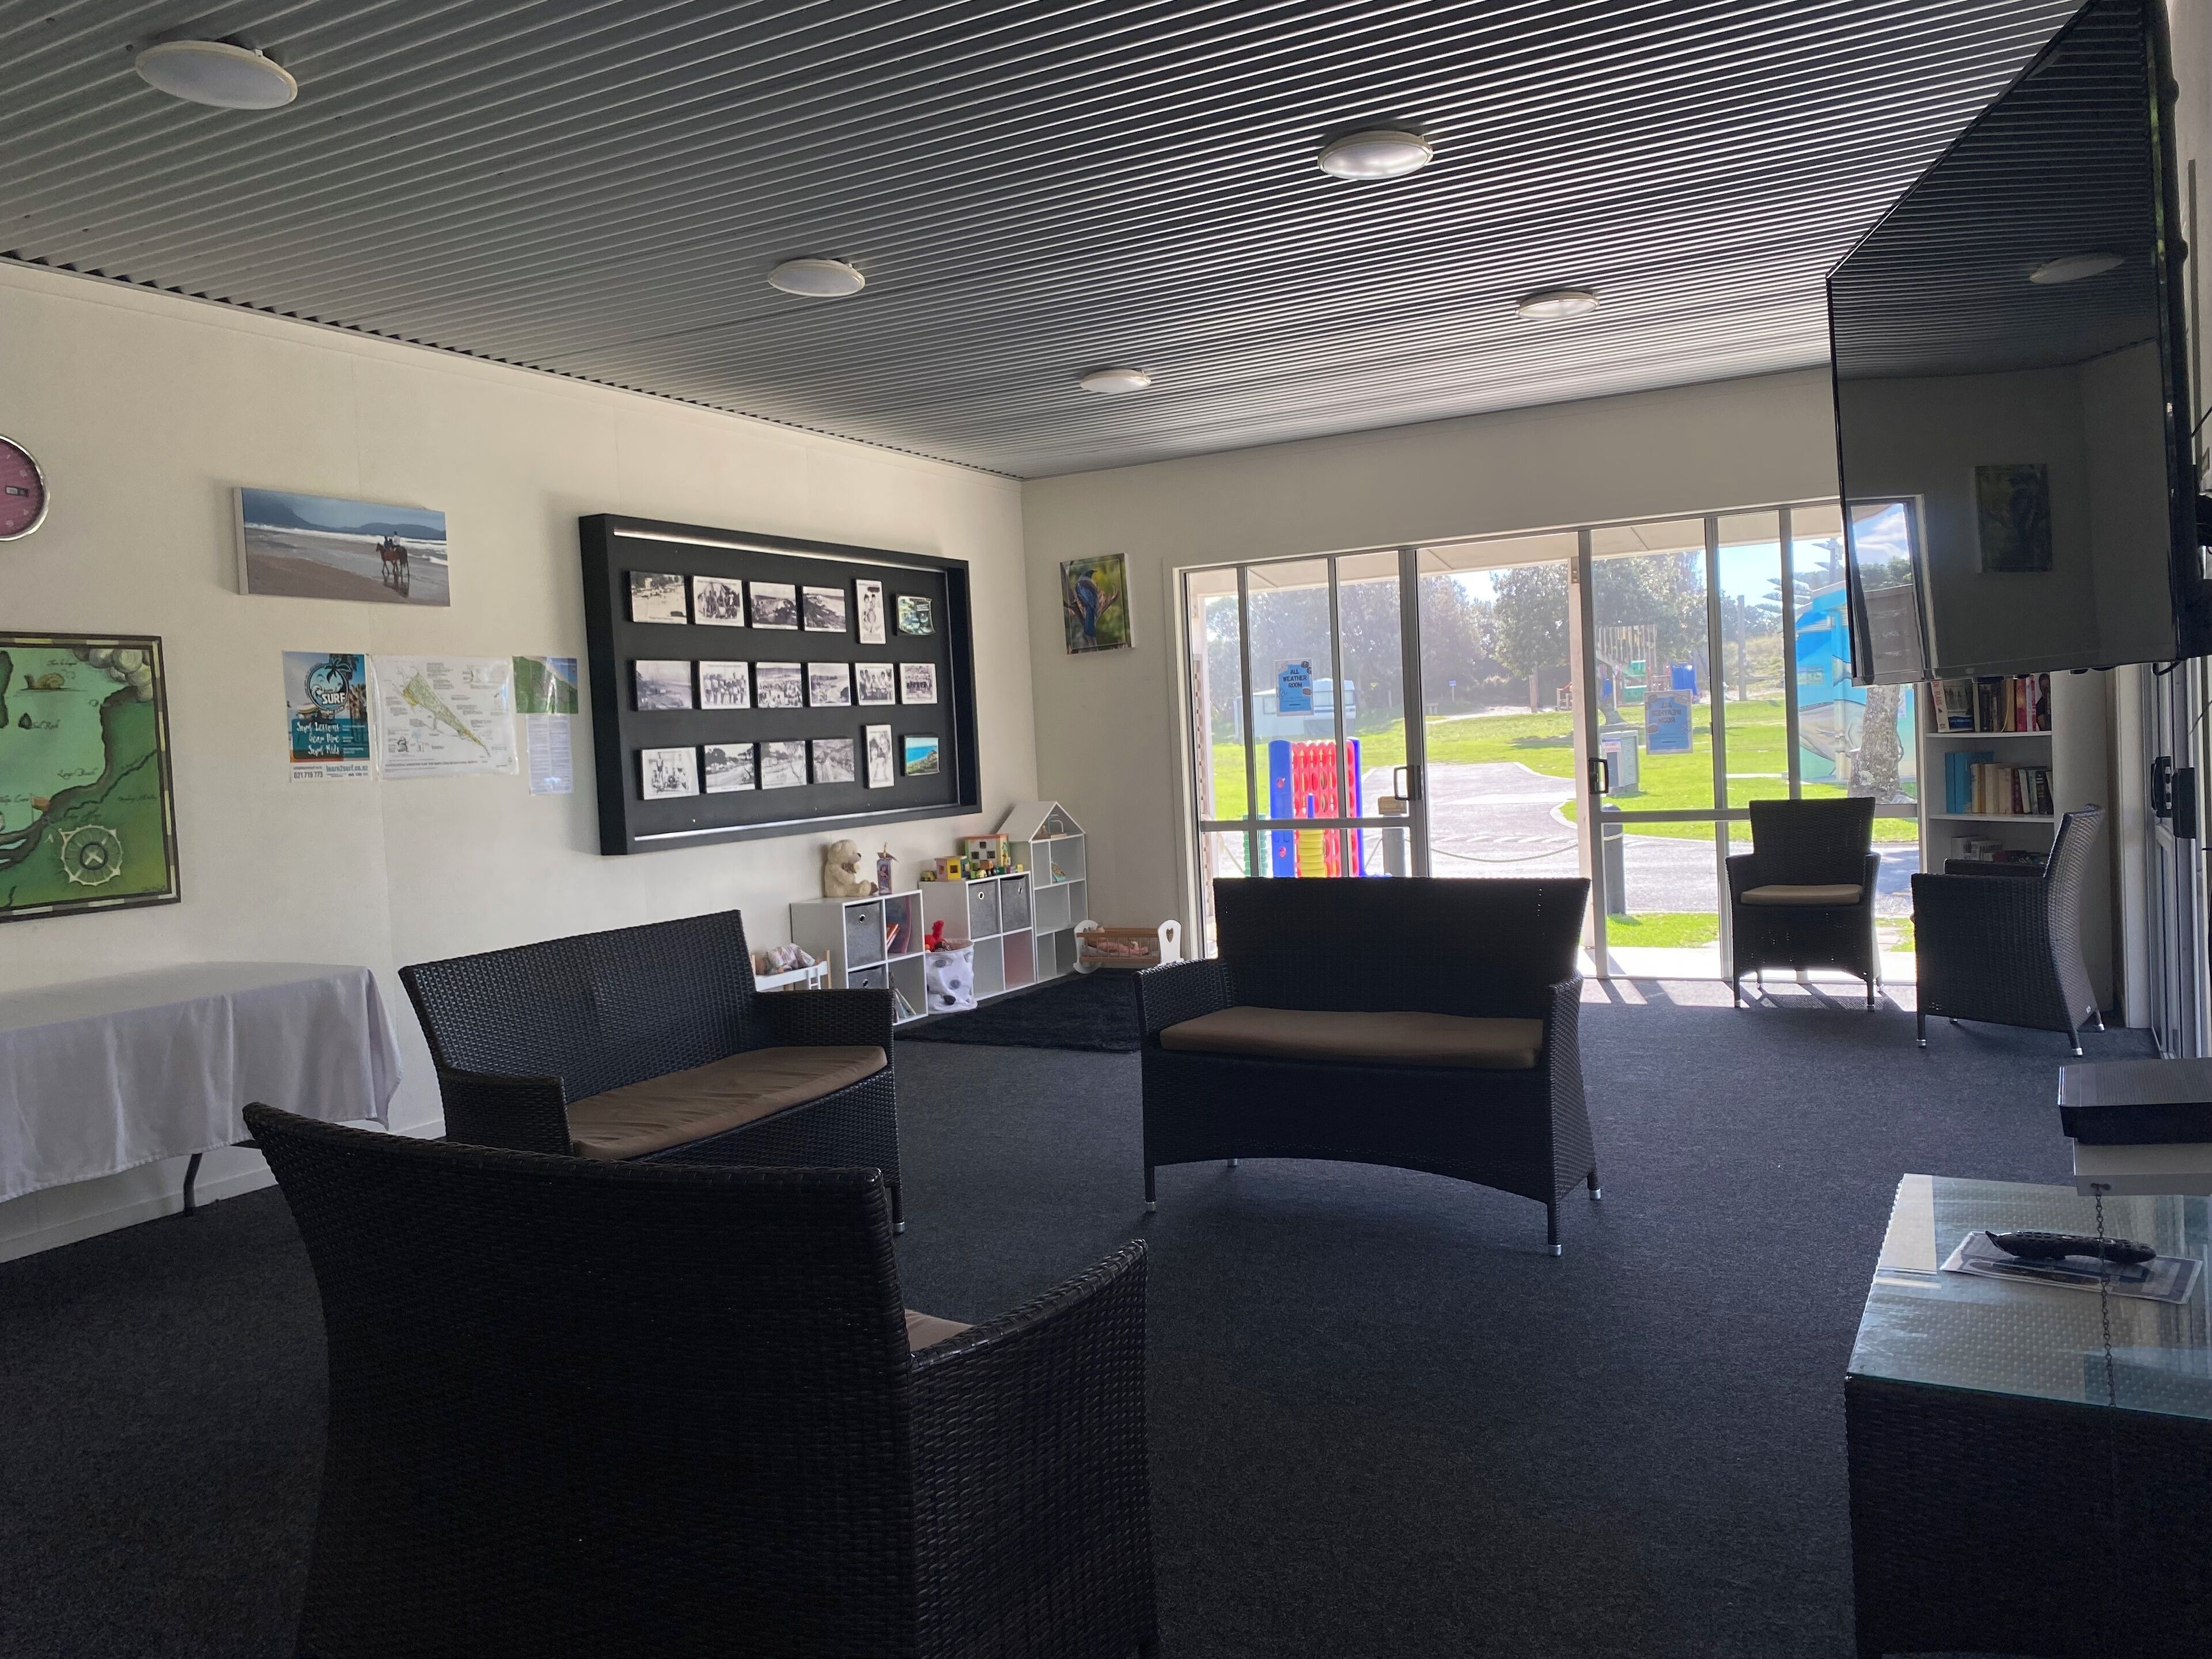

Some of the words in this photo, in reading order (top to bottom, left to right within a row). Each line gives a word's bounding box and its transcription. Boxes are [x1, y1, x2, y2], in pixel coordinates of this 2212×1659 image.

[323, 692, 346, 704] SURF
[309, 733, 324, 743] Gear
[325, 744, 340, 756] Kids
[305, 771, 313, 779] 719
